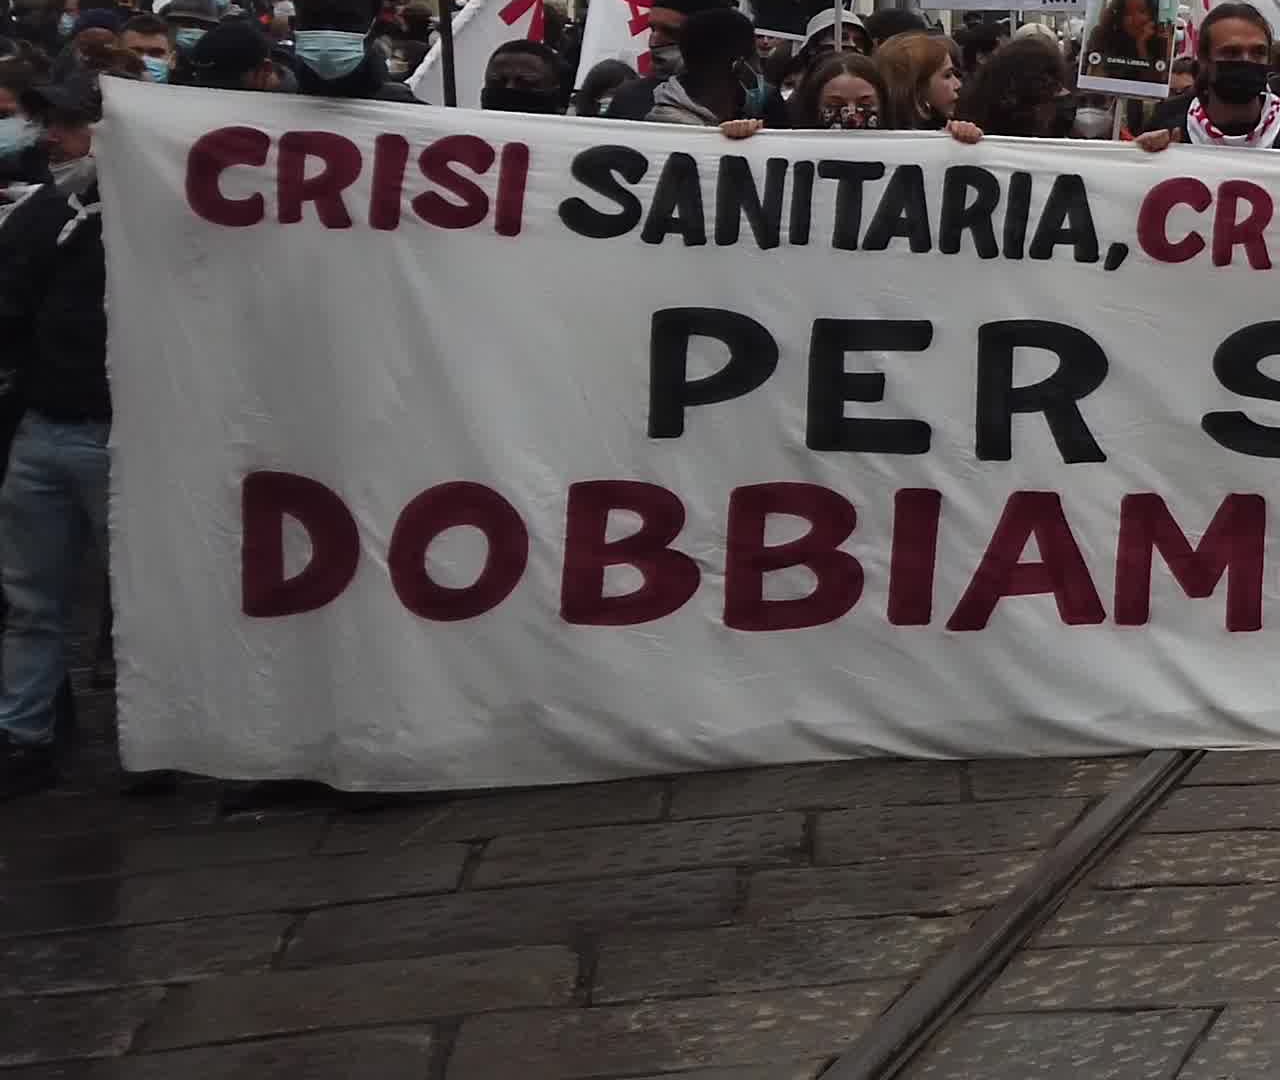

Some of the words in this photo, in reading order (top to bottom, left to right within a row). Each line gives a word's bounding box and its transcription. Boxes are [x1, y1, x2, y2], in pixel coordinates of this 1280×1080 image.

[184, 125, 530, 239] CRISI
[557, 143, 1130, 272] SANITARIA,
[647, 306, 1110, 465] PER
